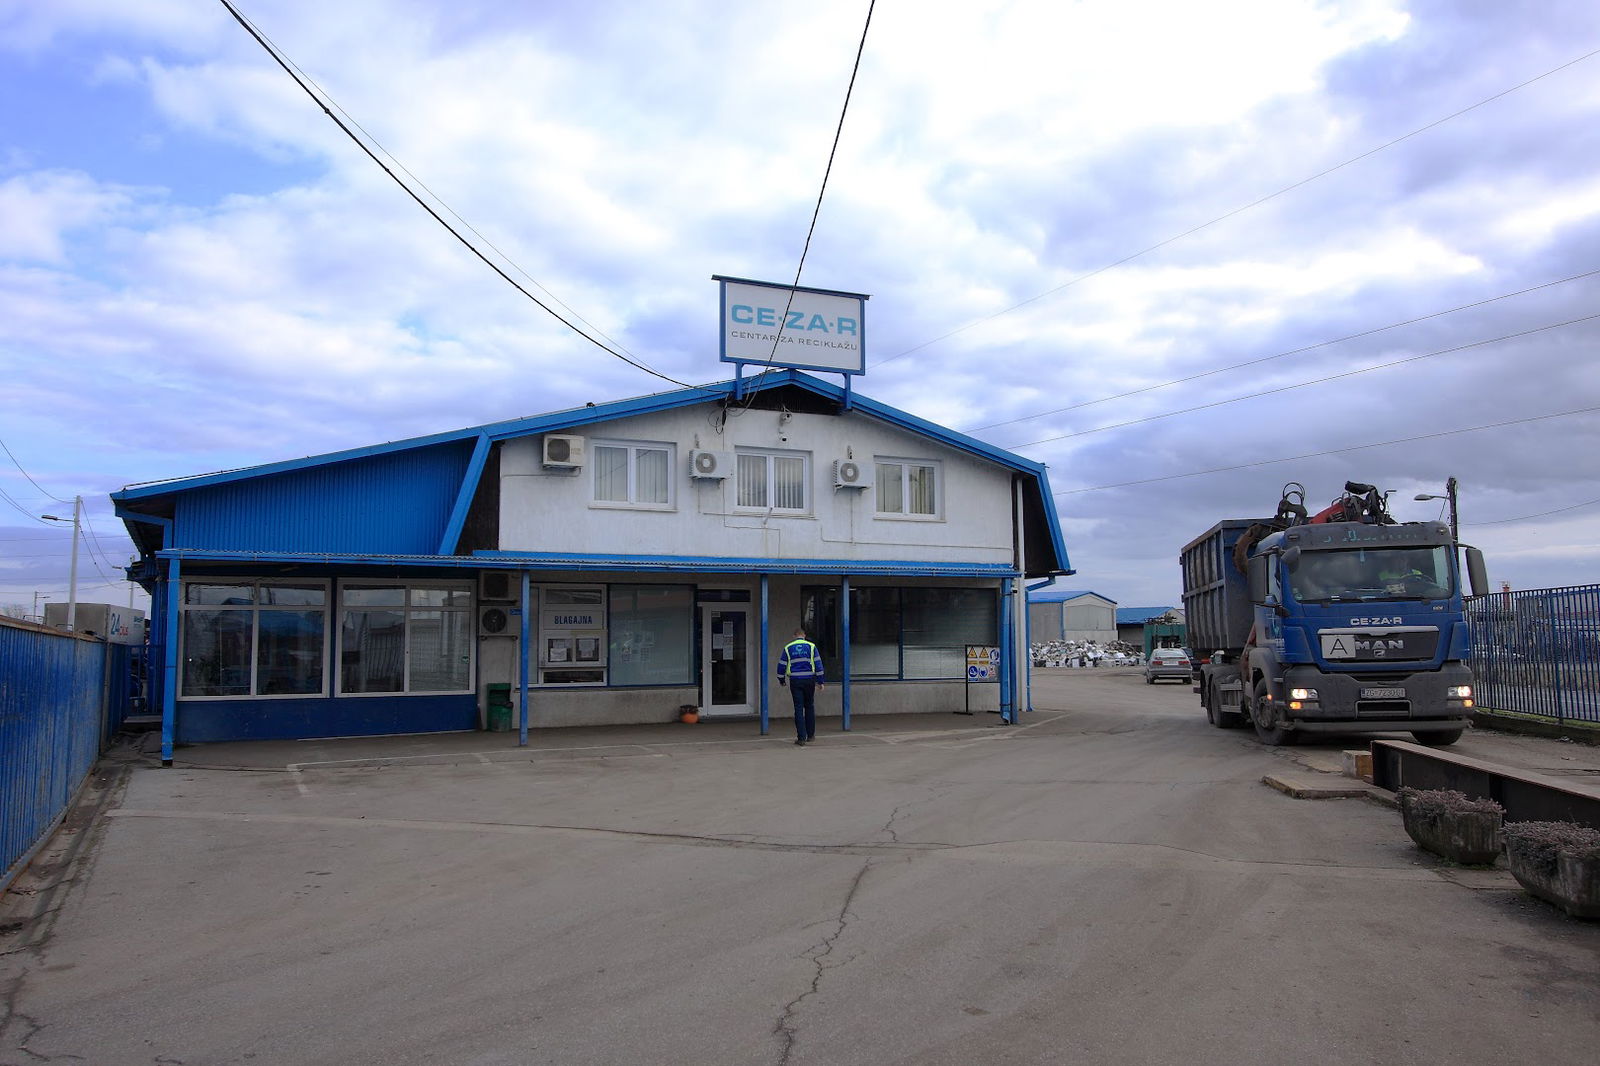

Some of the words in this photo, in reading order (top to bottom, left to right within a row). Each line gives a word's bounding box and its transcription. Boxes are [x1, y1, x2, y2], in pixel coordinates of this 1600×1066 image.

[731, 330, 777, 343] CENTAR
[780, 337, 795, 345] ZA
[798, 338, 858, 351] RECIKLAŽU
[554, 615, 593, 625] BLAGAJNA
[1330, 638, 1348, 655] A
[1355, 640, 1404, 649] MAN
